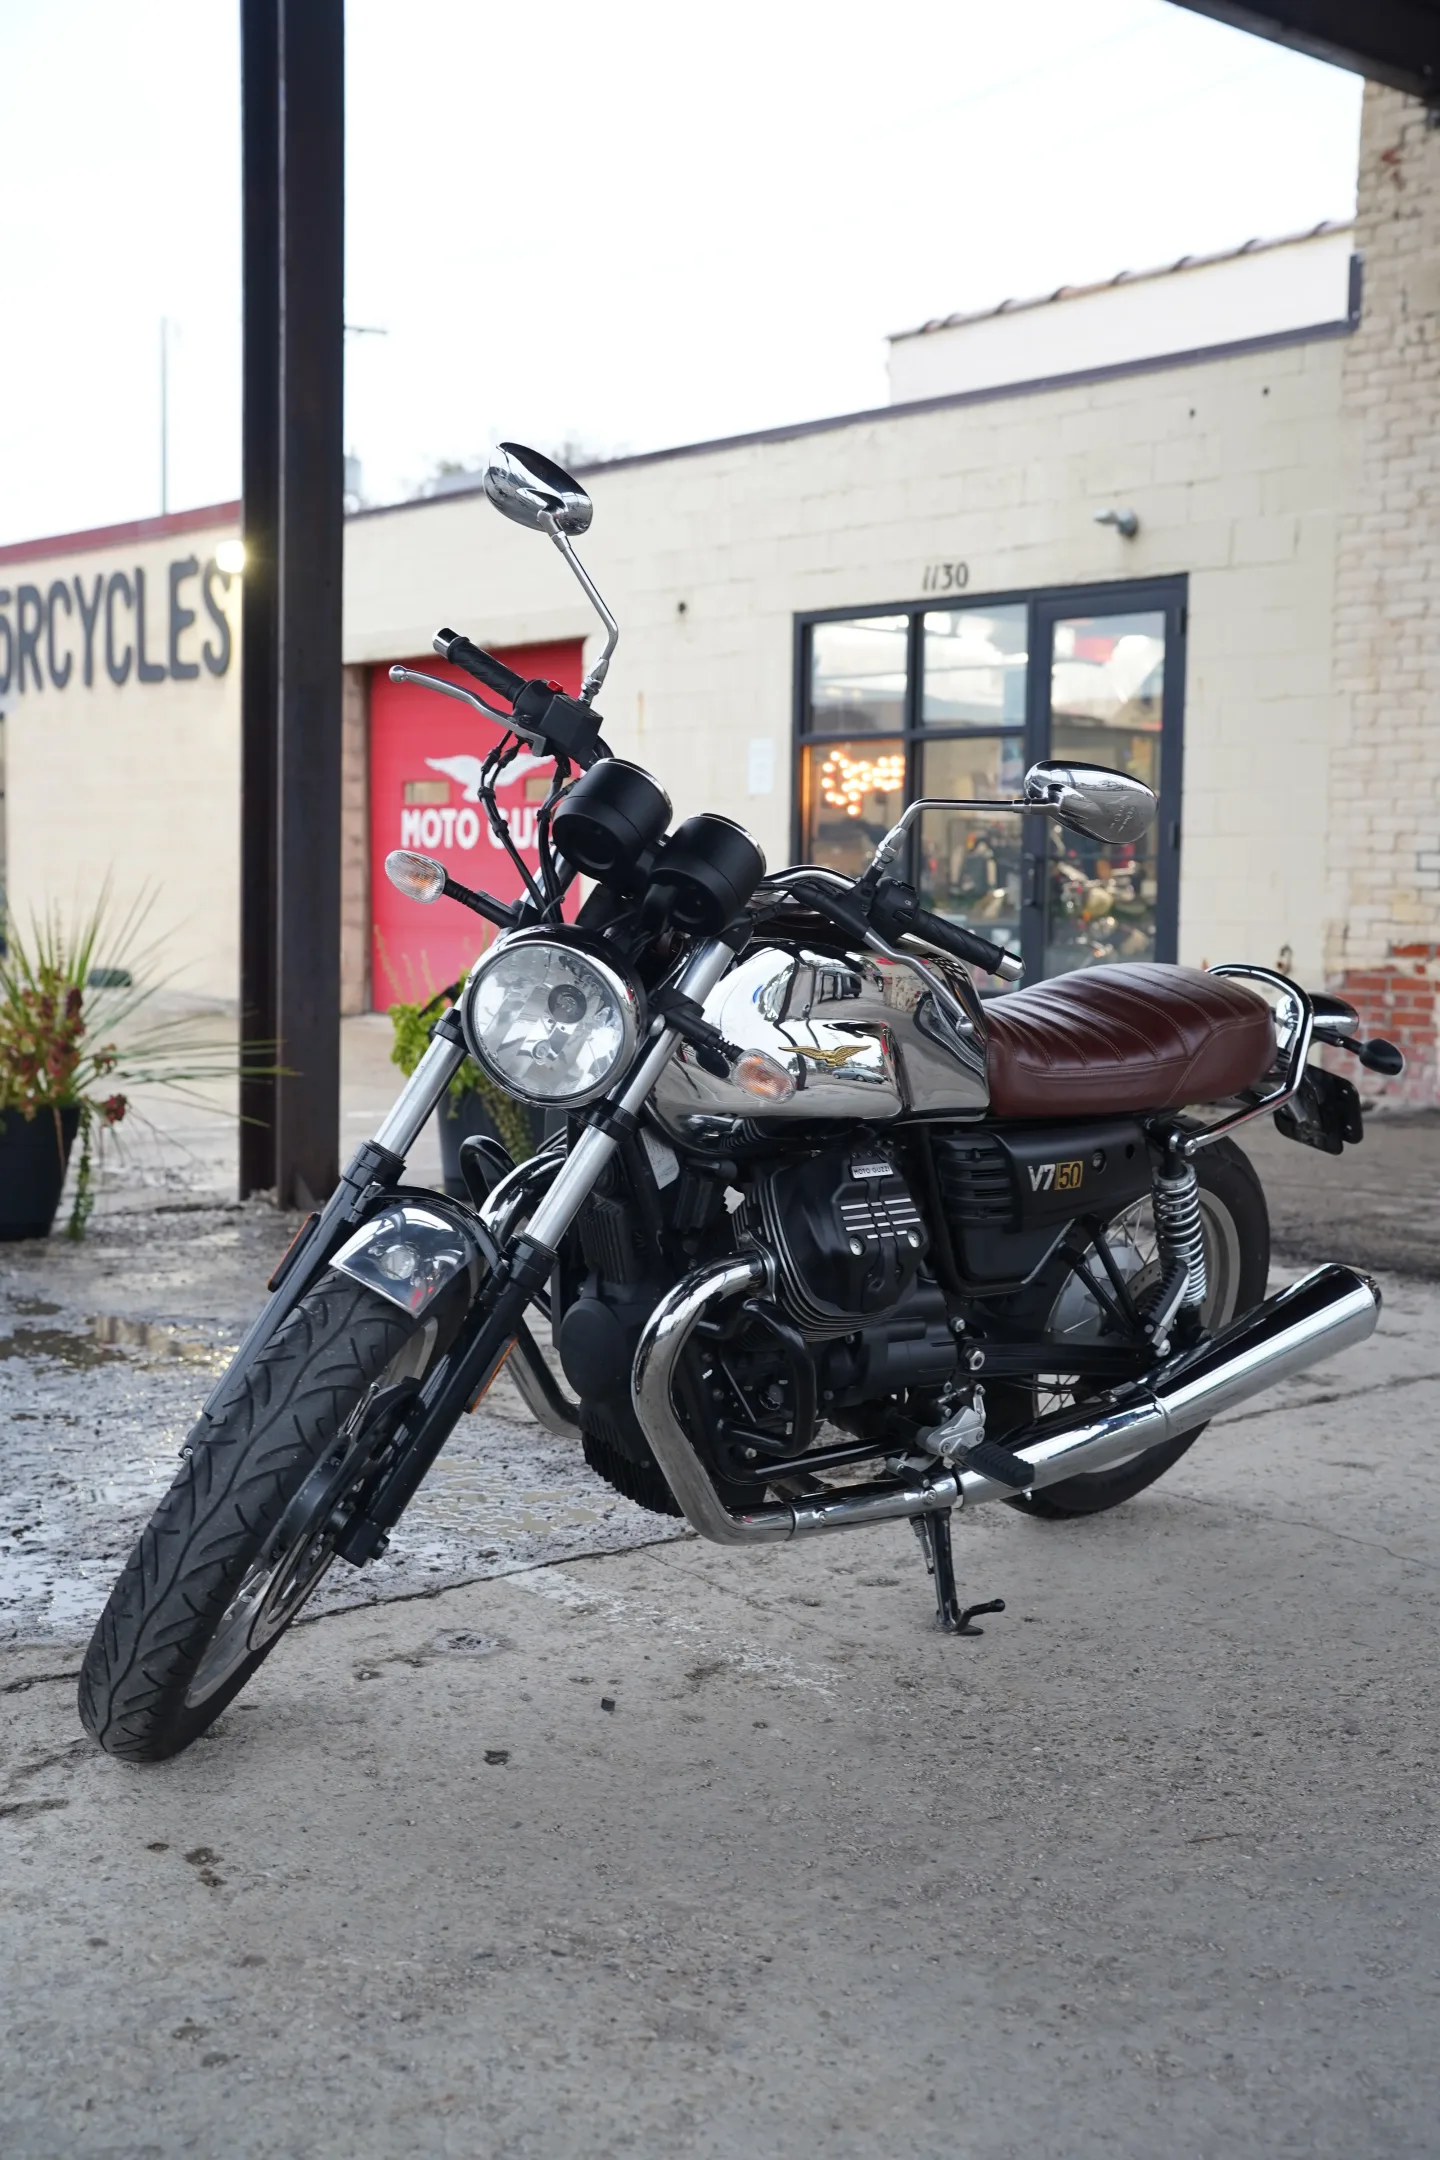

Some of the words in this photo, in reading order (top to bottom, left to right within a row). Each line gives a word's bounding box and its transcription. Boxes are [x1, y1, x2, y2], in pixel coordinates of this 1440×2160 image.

[922, 561, 969, 592] 1130
[402, 808, 480, 850] MOTO
[853, 1168, 871, 1176] MOTO
[872, 1165, 891, 1174] GUZZI
